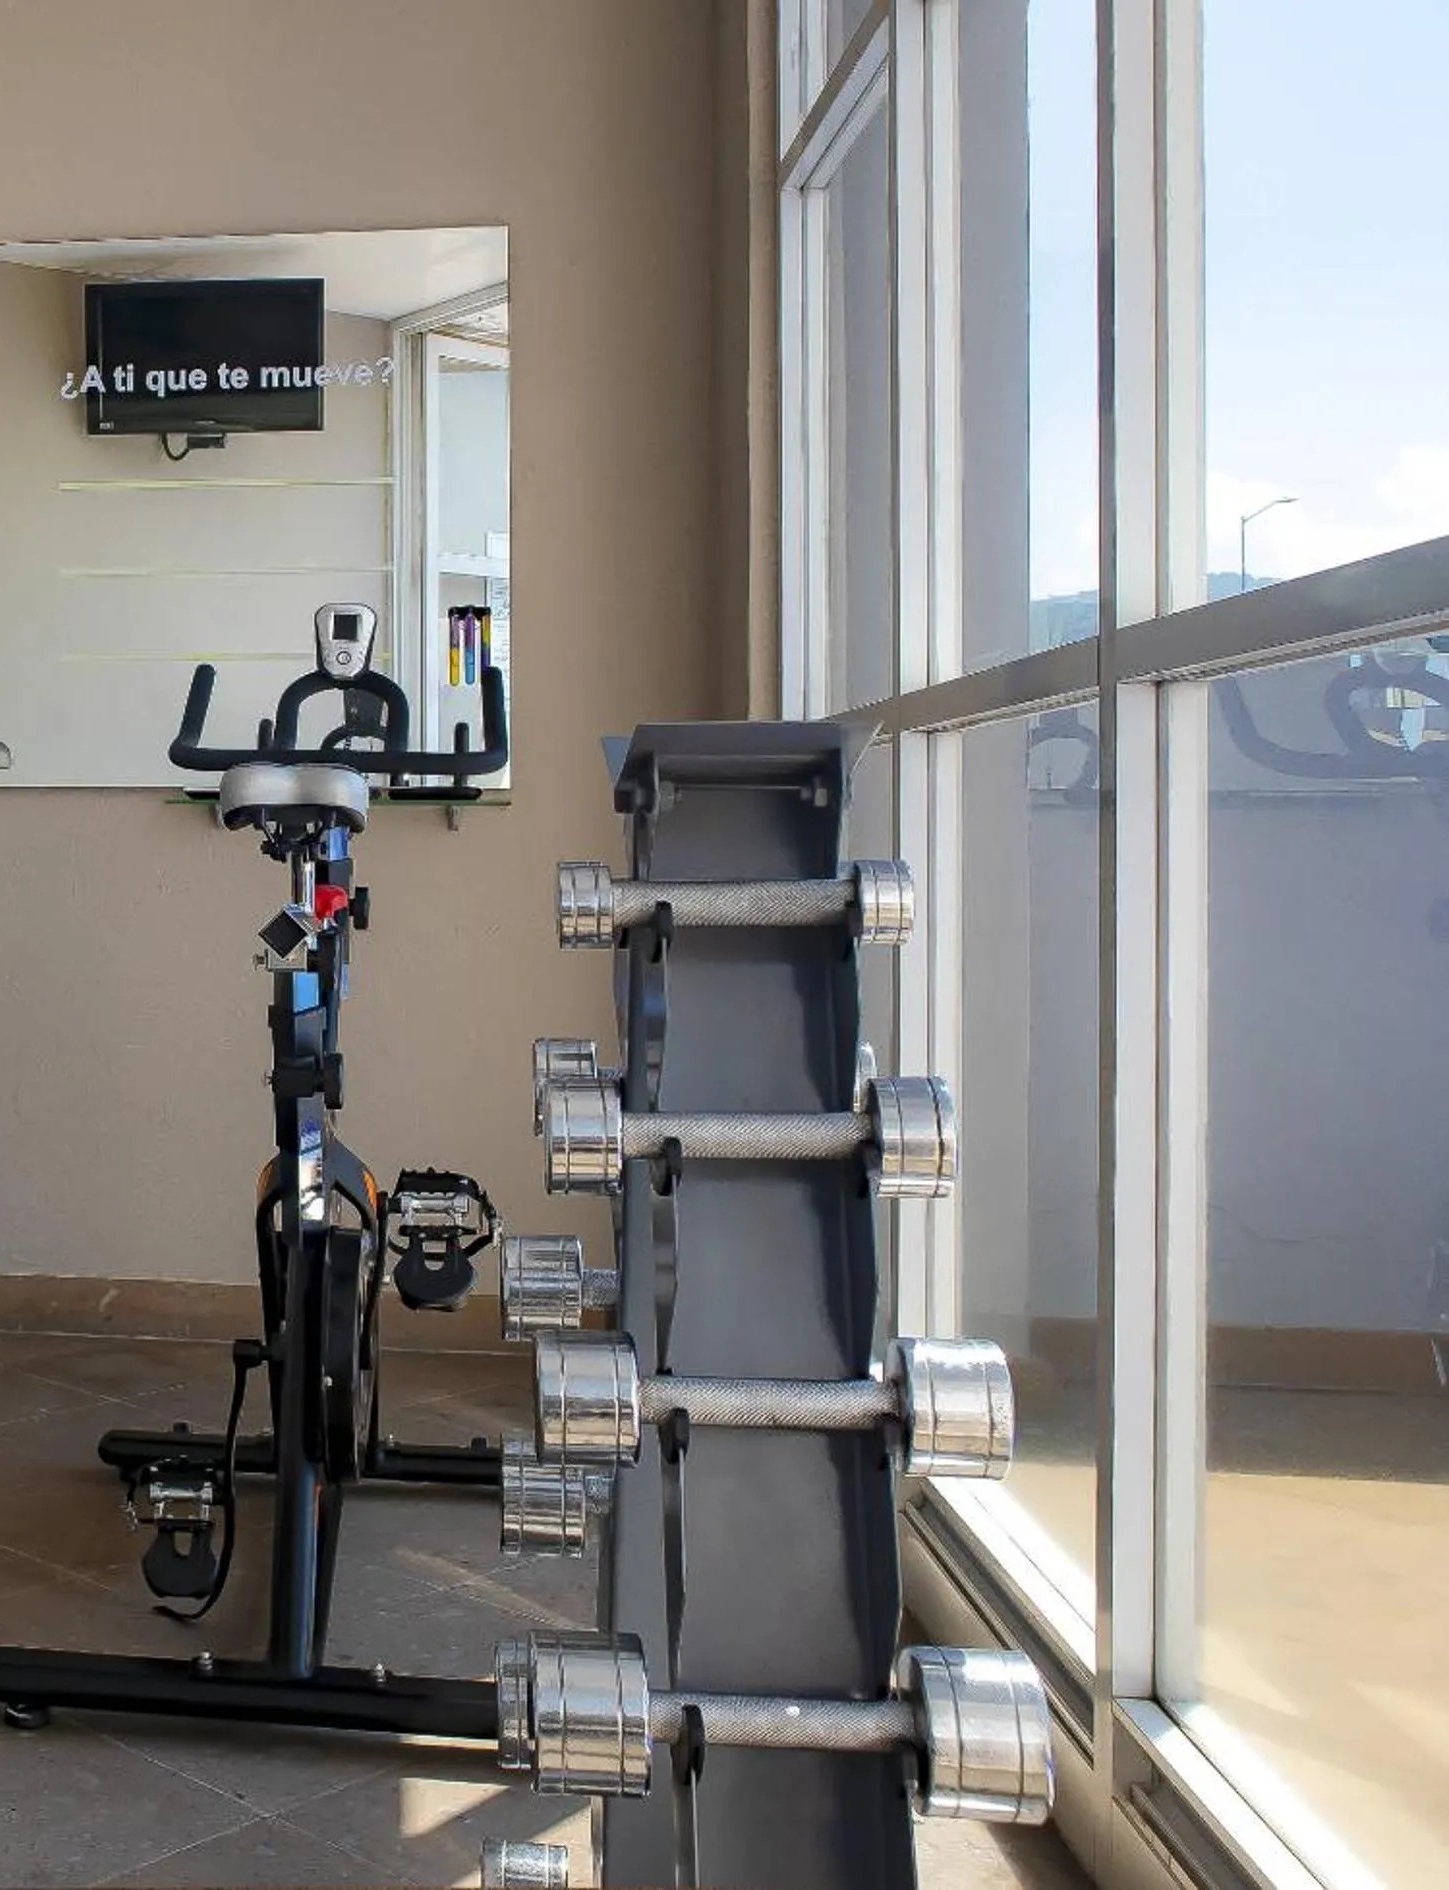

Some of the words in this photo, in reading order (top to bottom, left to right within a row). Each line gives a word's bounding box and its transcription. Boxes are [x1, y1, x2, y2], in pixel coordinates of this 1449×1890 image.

[60, 364, 106, 400] ¿A
[114, 363, 134, 392] ti
[145, 366, 207, 397] que
[218, 362, 249, 390] te
[260, 356, 395, 389] mueve?
